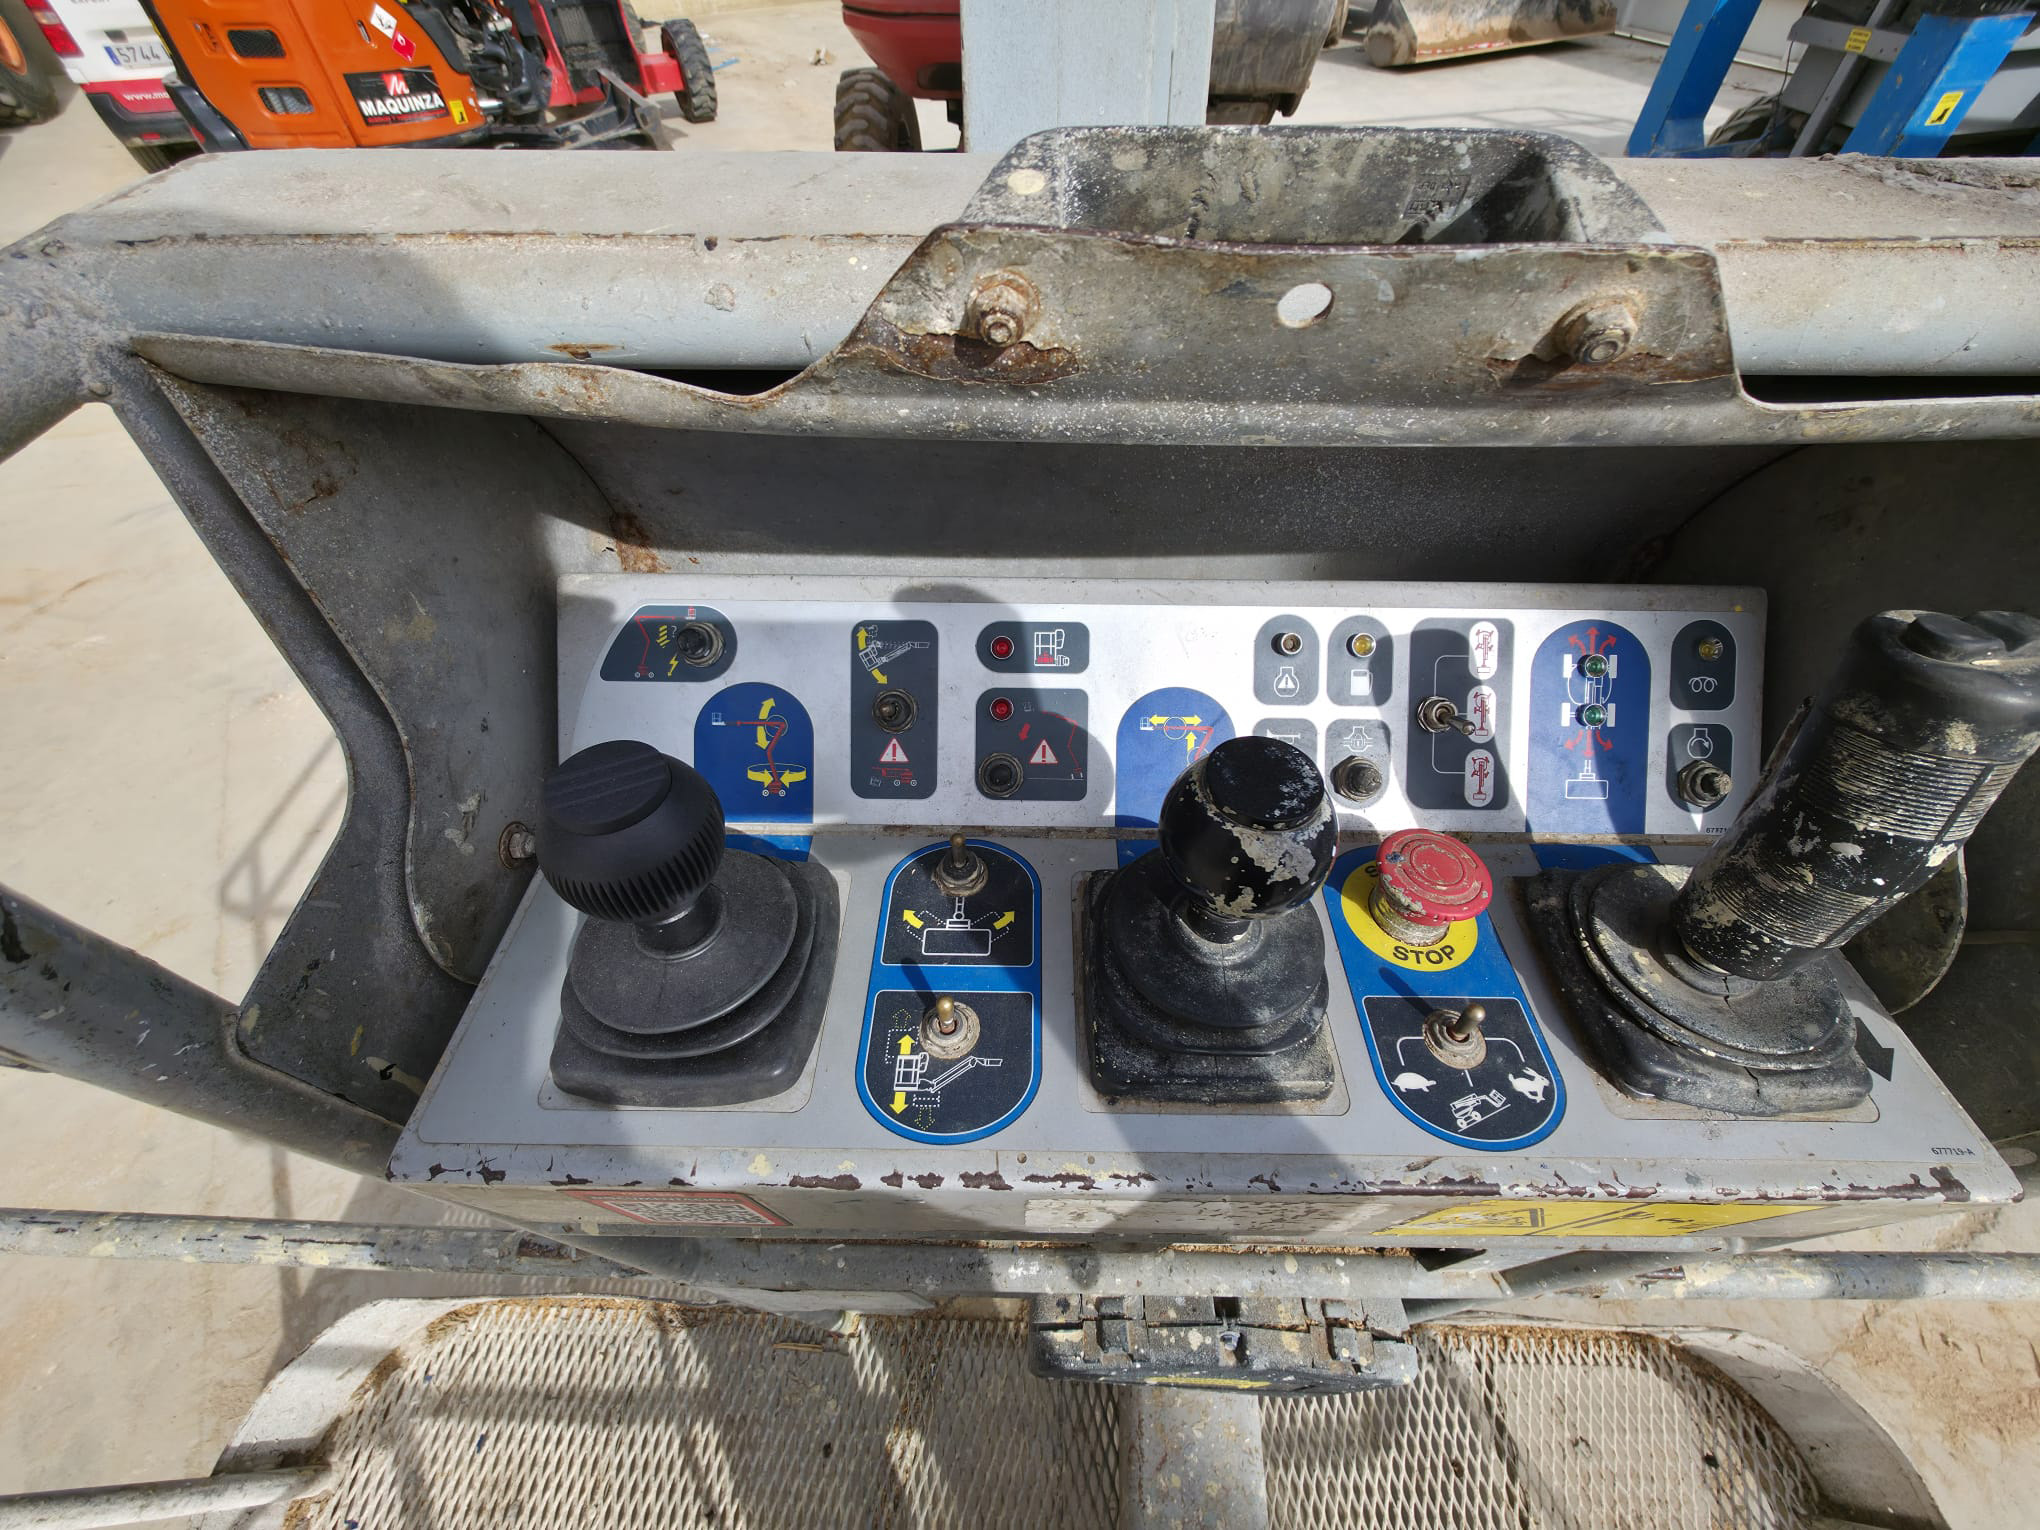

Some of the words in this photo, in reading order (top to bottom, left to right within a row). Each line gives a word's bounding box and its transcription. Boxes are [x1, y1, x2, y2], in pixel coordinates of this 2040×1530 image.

[116, 45, 161, 63] 5744
[358, 91, 446, 117] MAQUINZA
[1392, 944, 1455, 965] STOP
